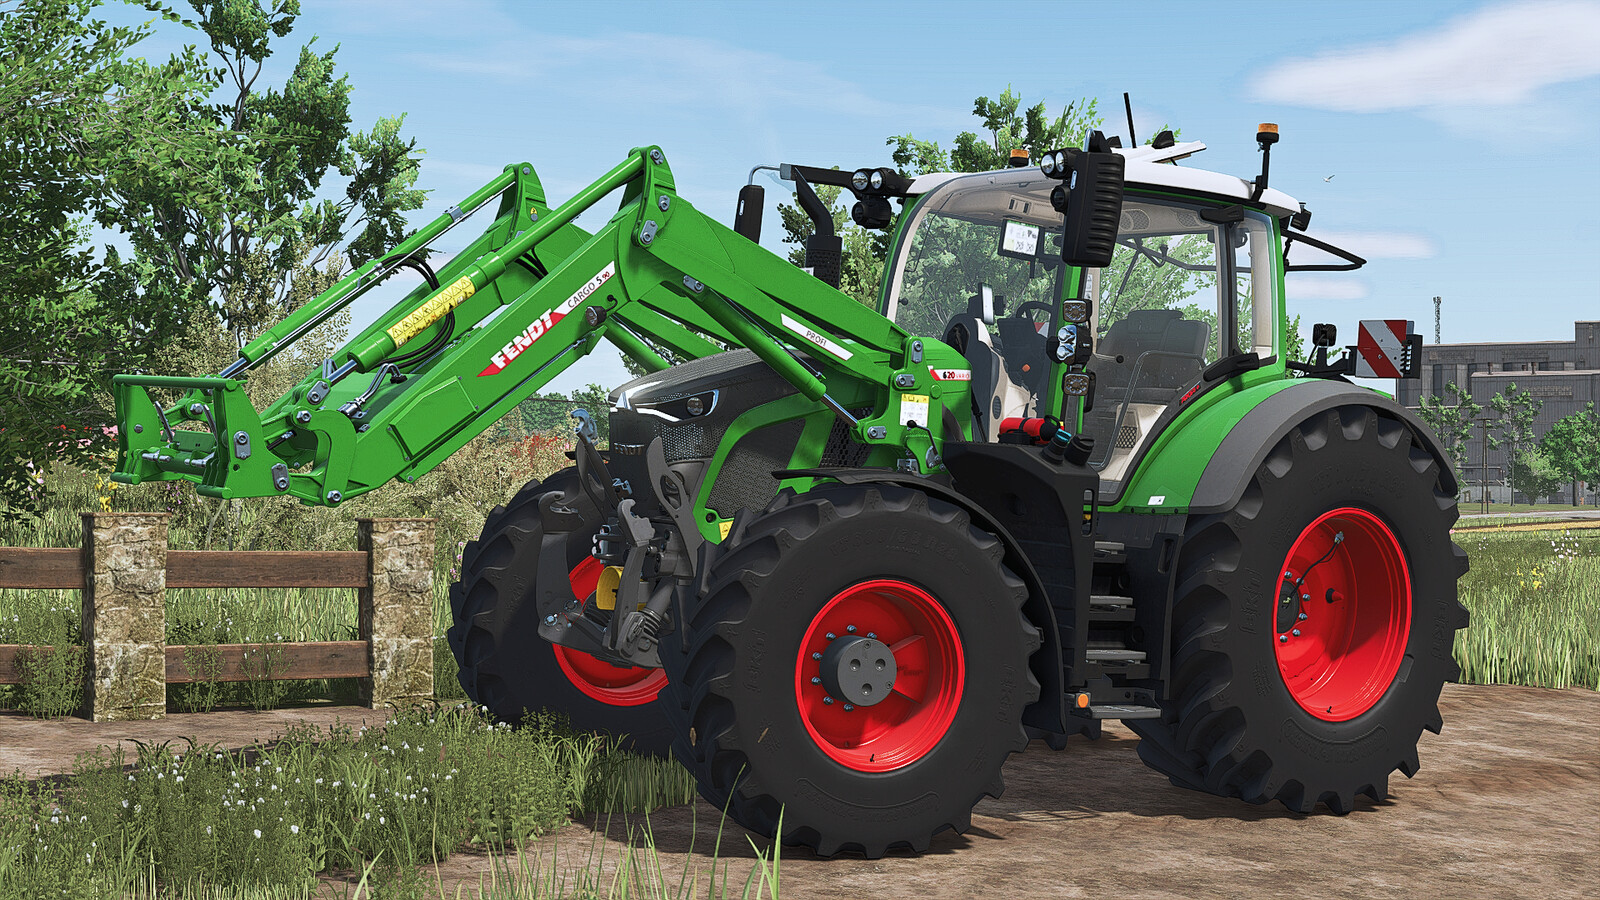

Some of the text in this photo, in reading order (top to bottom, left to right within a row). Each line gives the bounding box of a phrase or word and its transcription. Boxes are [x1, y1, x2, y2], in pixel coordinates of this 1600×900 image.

[490, 308, 553, 369] FENDT
[567, 282, 596, 308] CARGO
[805, 330, 827, 347] PROFI
[942, 371, 956, 379] 620
